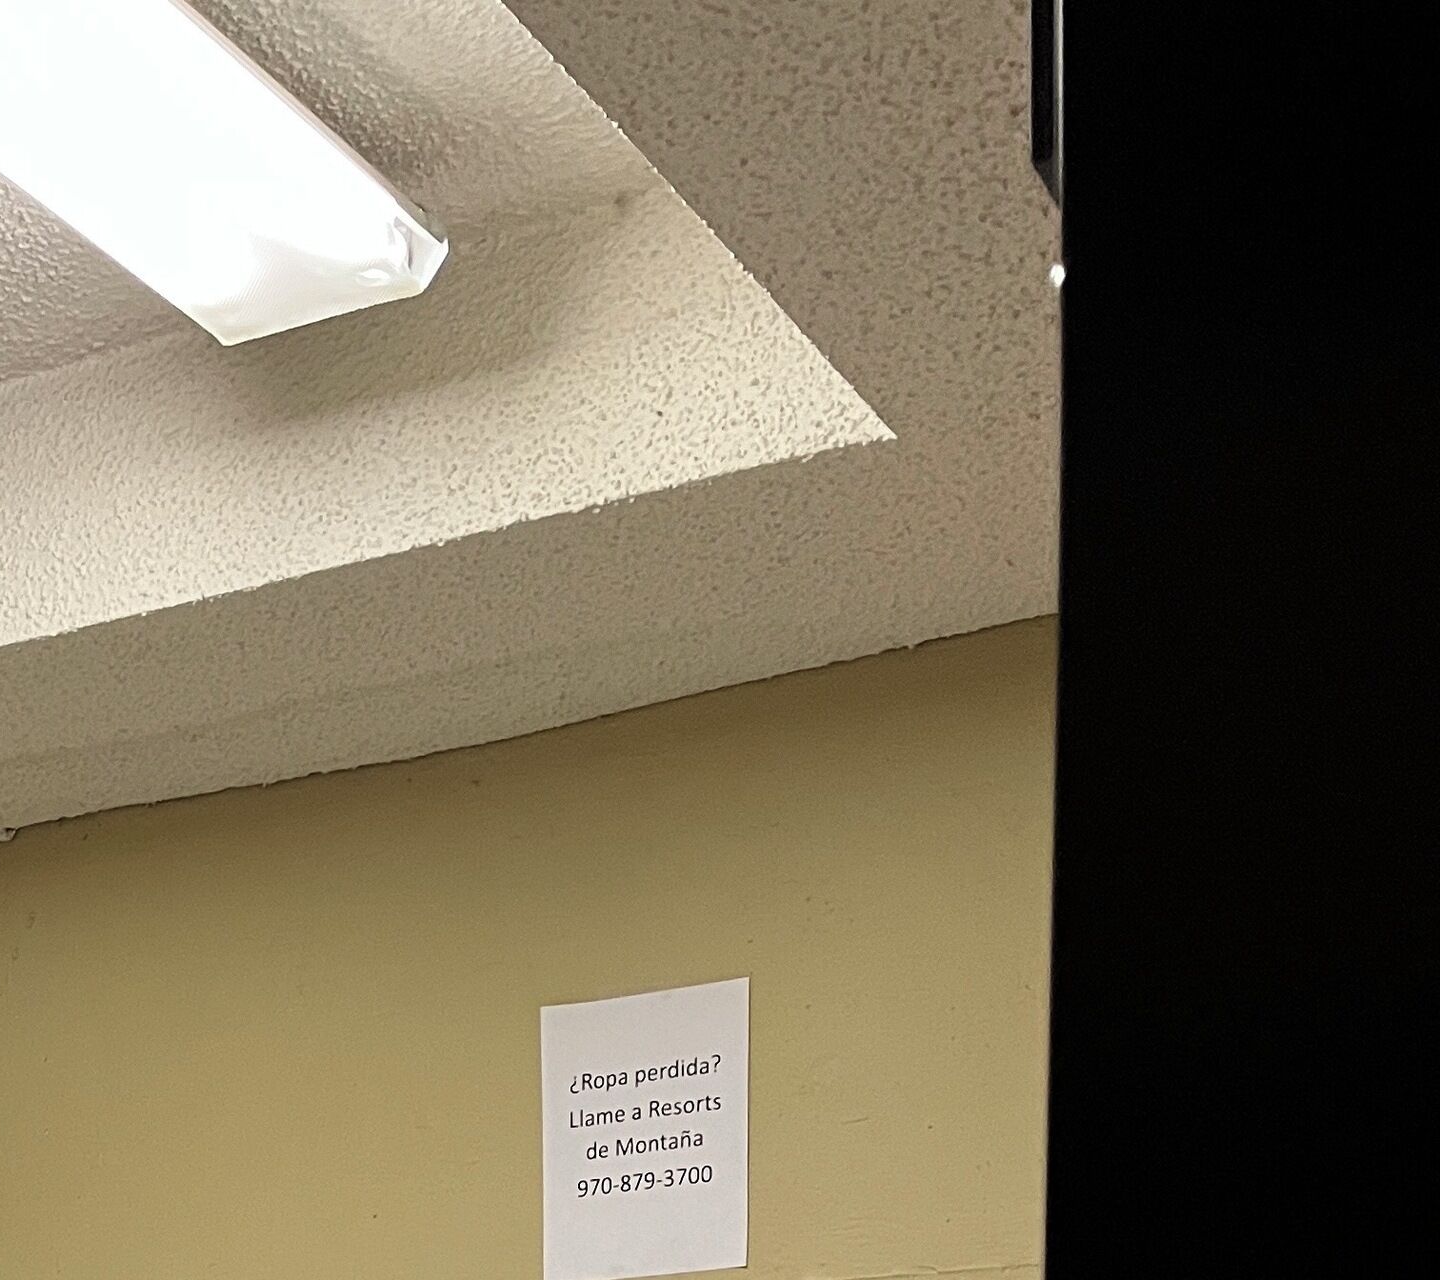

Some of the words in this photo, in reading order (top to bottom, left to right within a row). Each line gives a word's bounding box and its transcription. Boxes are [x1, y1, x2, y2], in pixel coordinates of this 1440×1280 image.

[569, 1070, 628, 1094] ¿Ropa
[635, 1054, 722, 1087] perdida?
[569, 1108, 626, 1128] Llame
[632, 1108, 642, 1121] a
[649, 1095, 722, 1118] Resorts
[586, 1141, 609, 1160] de
[616, 1130, 703, 1156] Montaña
[577, 1164, 713, 1198] 970-879-3700
